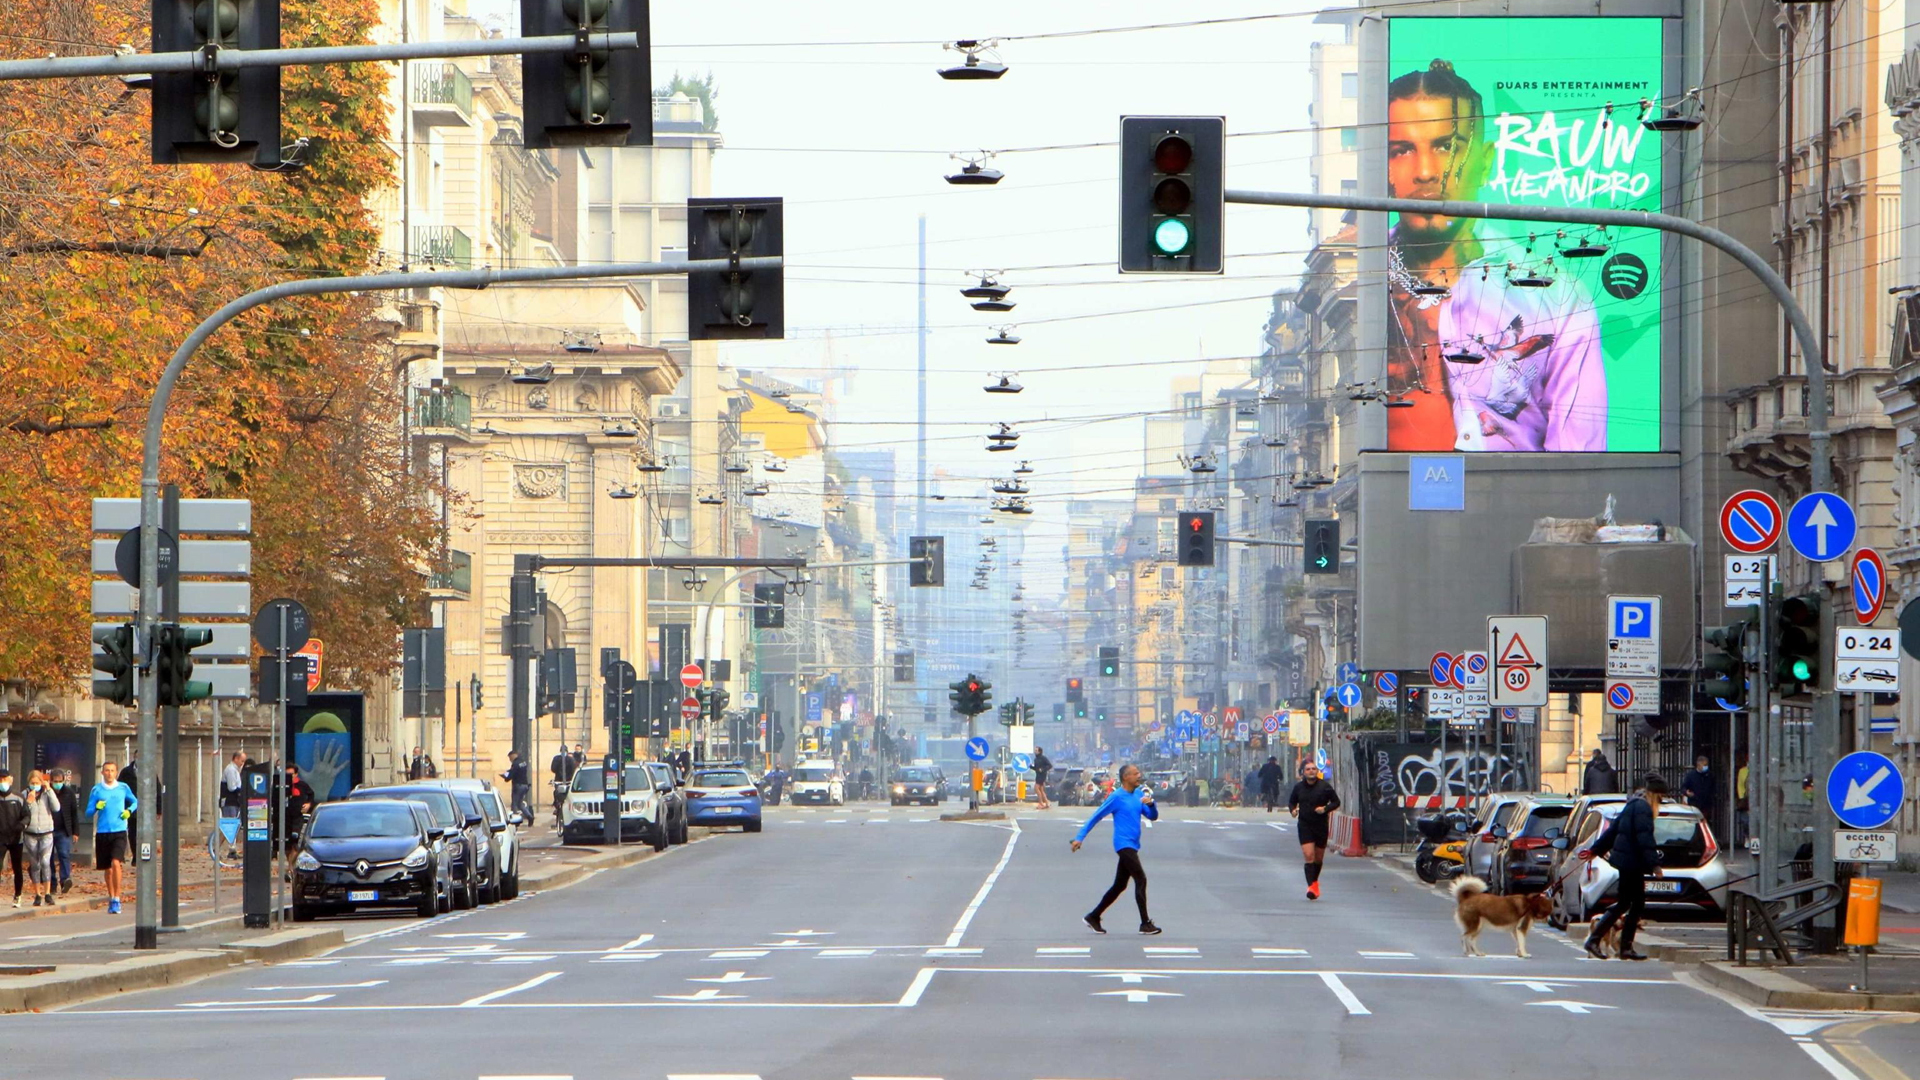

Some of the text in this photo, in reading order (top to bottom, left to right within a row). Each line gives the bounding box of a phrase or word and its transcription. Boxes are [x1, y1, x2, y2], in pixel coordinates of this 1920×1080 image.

[1496, 81, 1649, 89] DUARS ENTERTAINMENT
[1494, 91, 1660, 169] RAUW
[1490, 167, 1650, 207] ALEJANDRO
[1622, 606, 1644, 634] P
[1510, 673, 1525, 685] 30
[253, 775, 263, 790] P
[1846, 833, 1885, 842] eccetto
